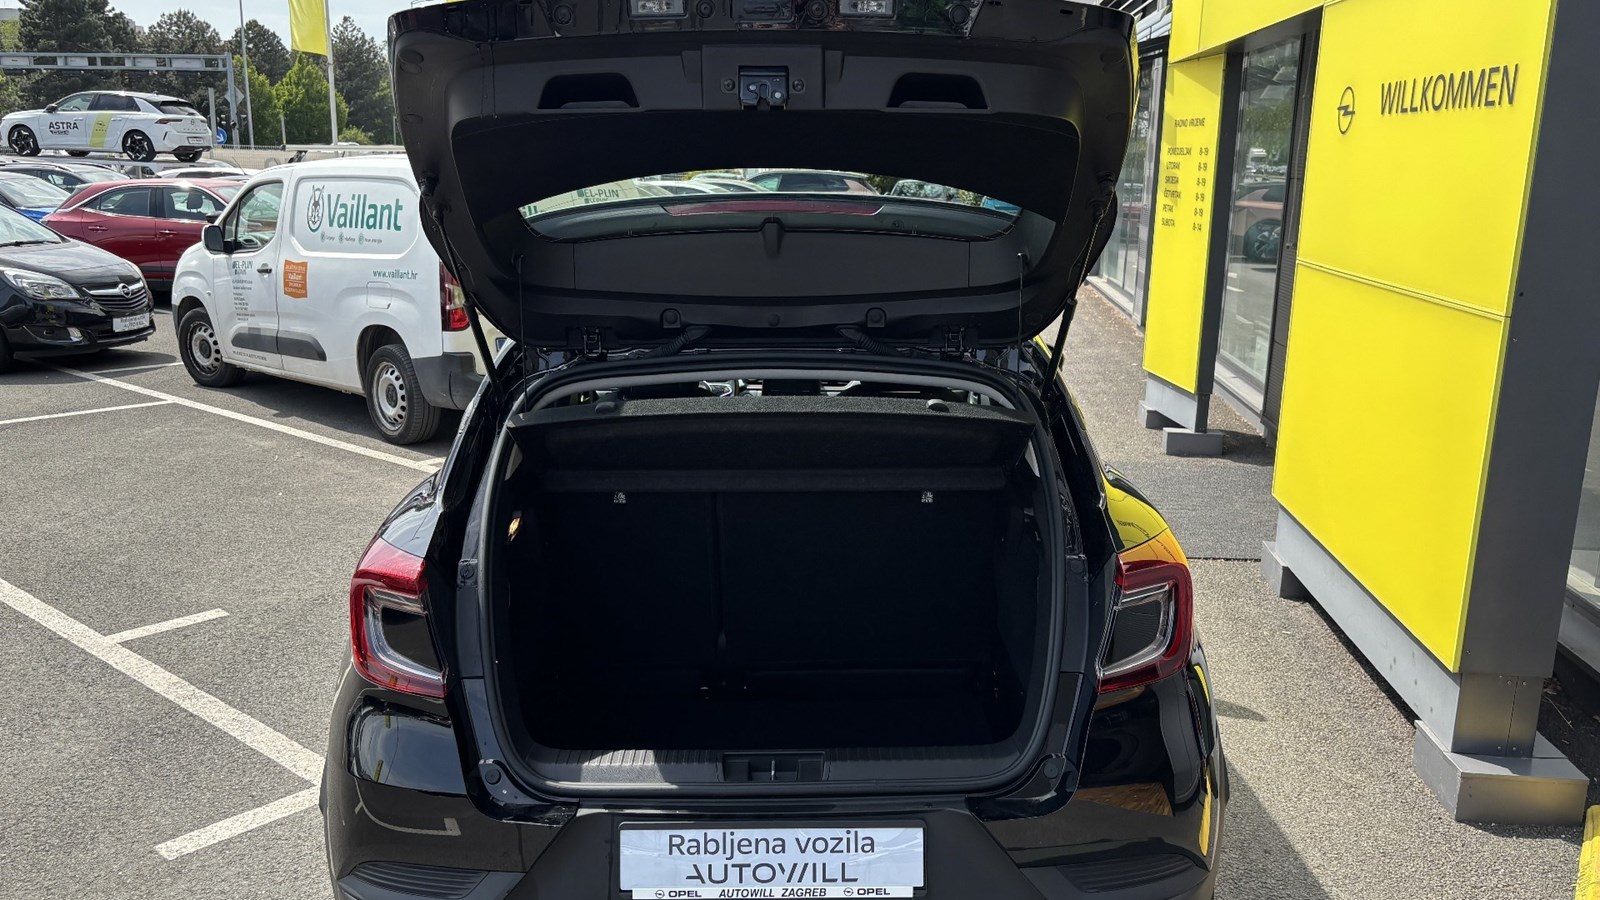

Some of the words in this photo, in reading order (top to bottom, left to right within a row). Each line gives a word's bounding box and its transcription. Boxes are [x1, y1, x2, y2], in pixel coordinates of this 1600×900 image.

[1381, 63, 1519, 116] WILLKOMMEN
[49, 121, 79, 130] ASTRA
[327, 193, 404, 231] Vaillant
[372, 269, 418, 280] www.vaillant.hr
[668, 831, 786, 860] Rabljena
[795, 829, 876, 854] vozila
[685, 862, 859, 885] AUTOWILL
[668, 889, 702, 898] OPEL
[718, 888, 775, 898] AUTOWILL
[781, 887, 827, 898] ZAGREB
[857, 887, 891, 897] OPEL
